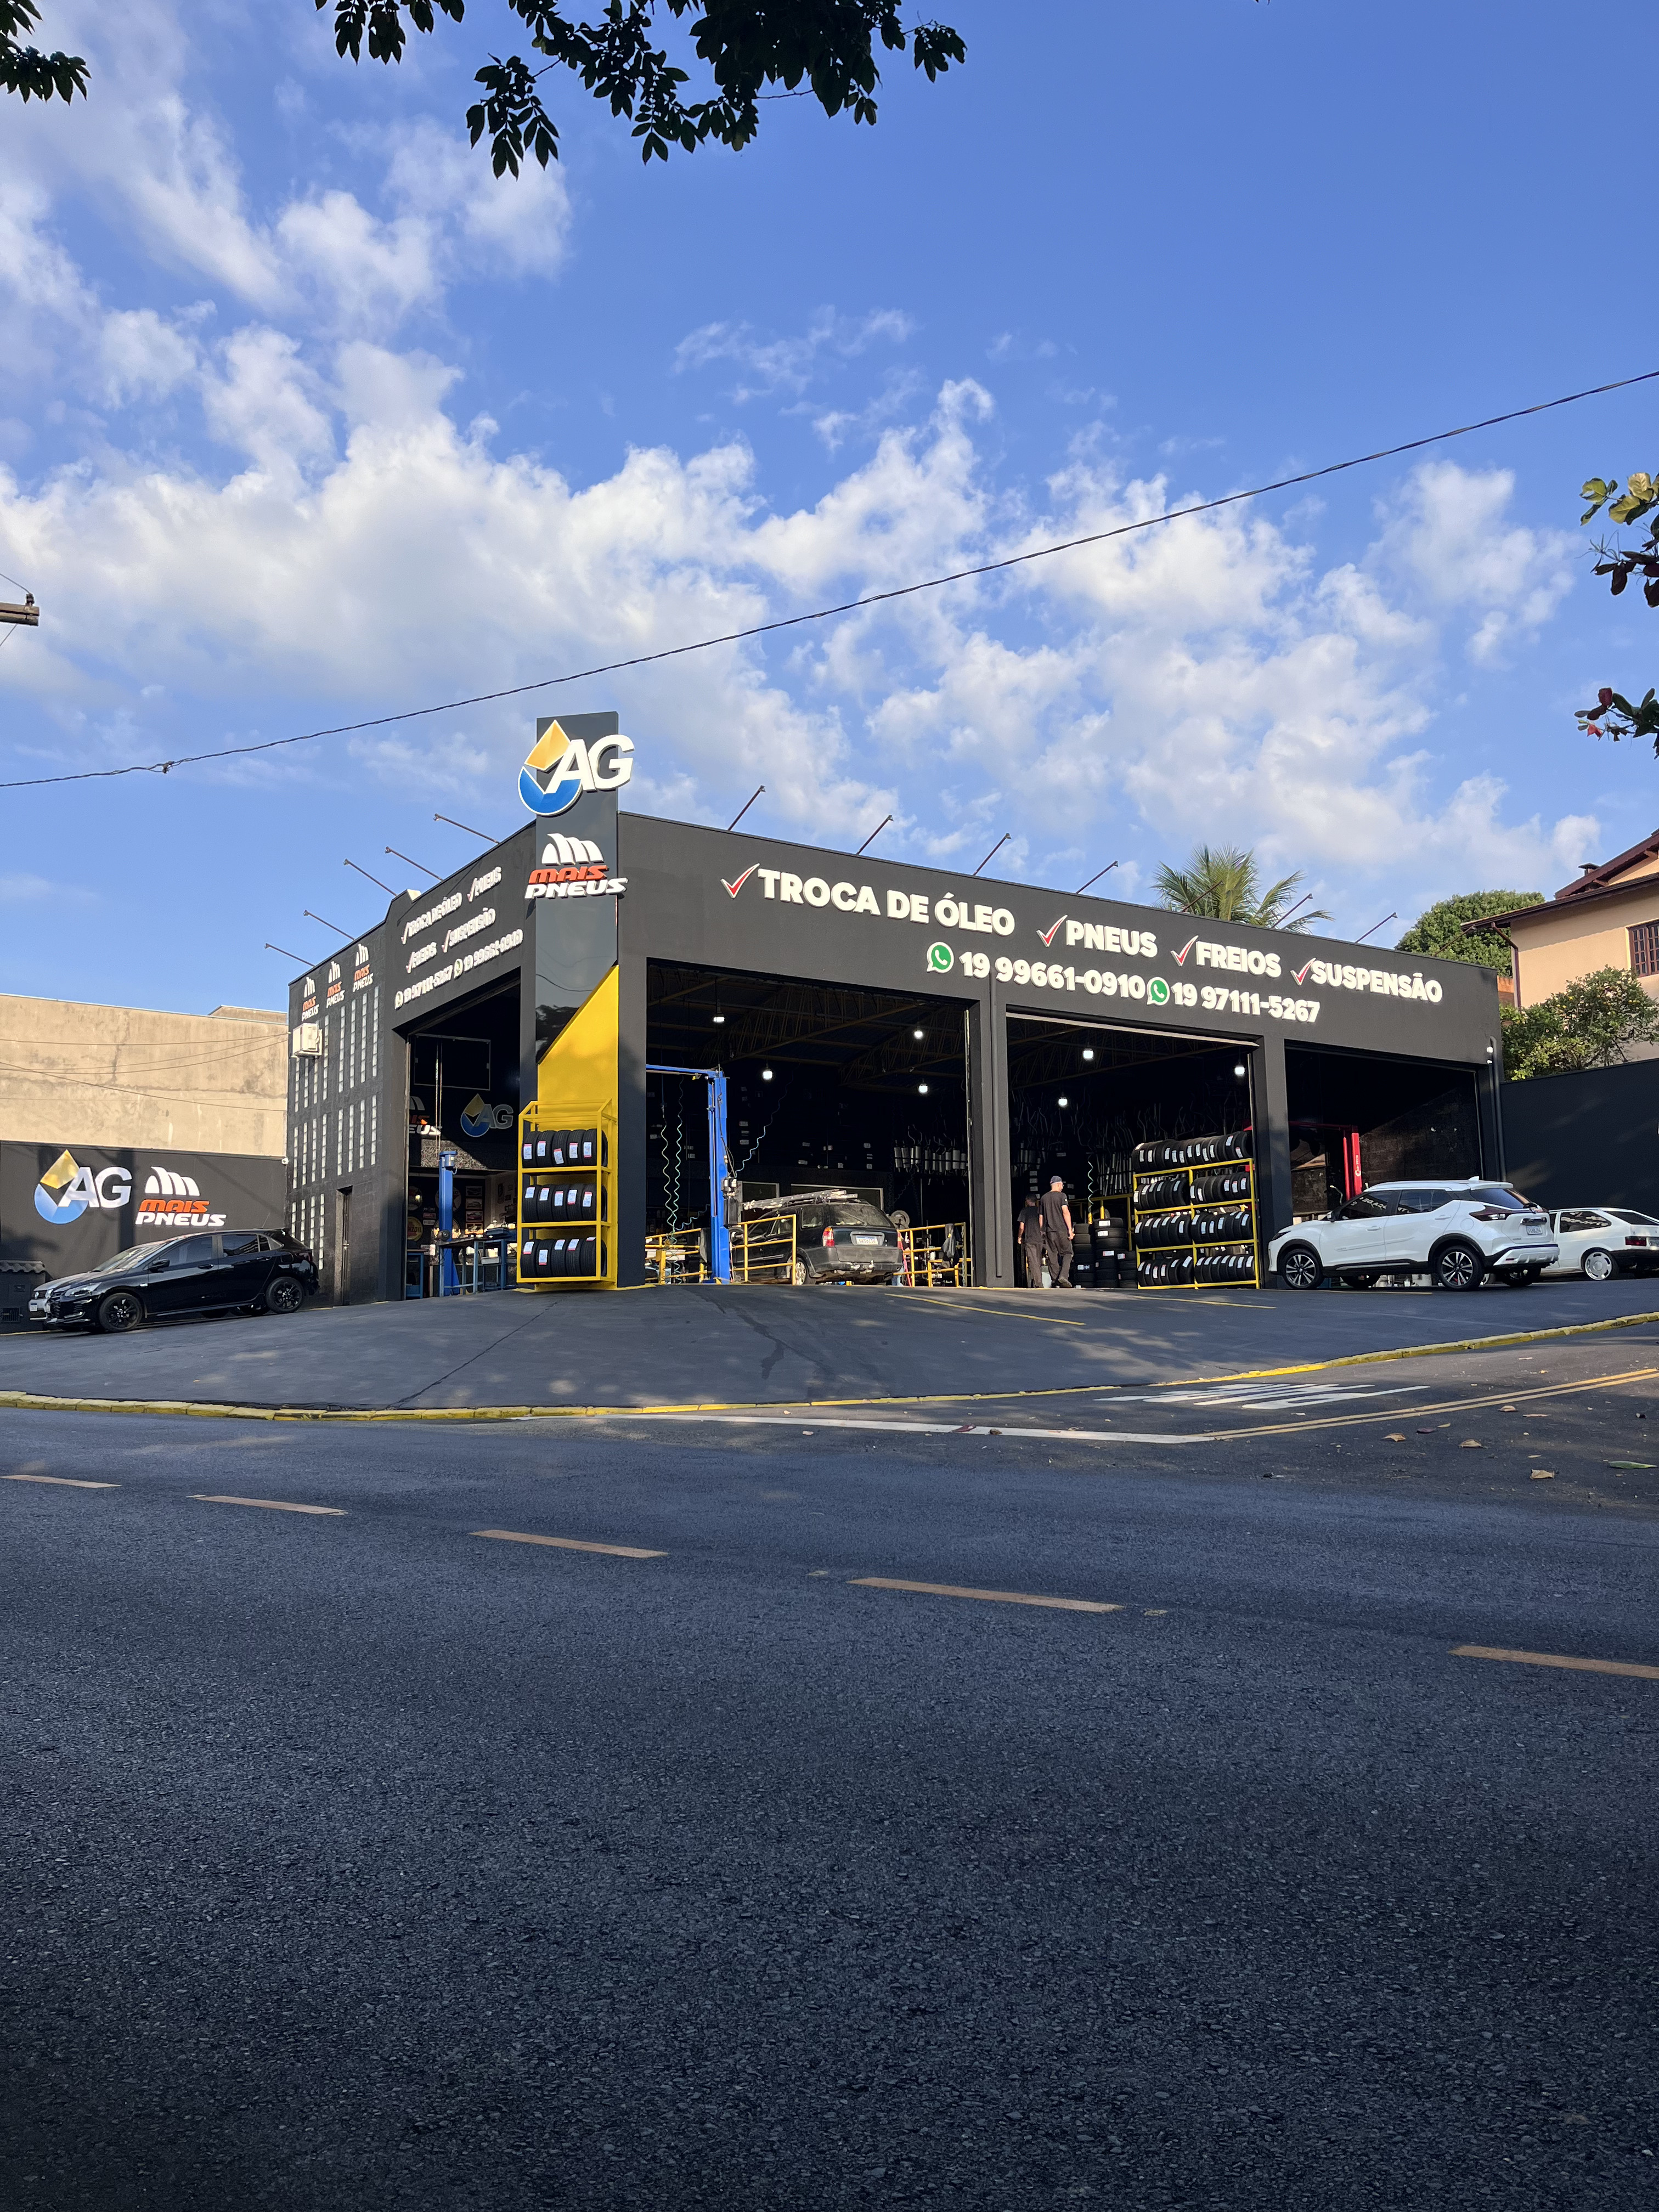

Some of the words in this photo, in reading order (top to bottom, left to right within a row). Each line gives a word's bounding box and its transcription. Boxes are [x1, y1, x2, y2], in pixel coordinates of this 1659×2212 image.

[544, 734, 635, 794] AG
[475, 866, 502, 896] PNEUS
[528, 865, 609, 884] MAIS
[524, 877, 628, 899] PNEUS
[758, 868, 881, 916] TROCA
[887, 889, 929, 924] DE
[934, 892, 1015, 936] ÓLEO
[1065, 919, 1158, 959] PNEUS
[411, 941, 437, 968] FREIOS
[1195, 941, 1282, 979] FREIOS
[353, 973, 374, 992] PNEUS
[354, 964, 370, 981] MAIS
[959, 951, 990, 980] 19
[994, 956, 1145, 1000] 99661-0910
[1310, 960, 1443, 1003] SUSPENSÃO
[326, 990, 345, 1008] PNEUS
[328, 981, 342, 997] MAIS
[301, 1004, 319, 1022] PNEUS
[302, 996, 317, 1012] MAIS
[1172, 981, 1198, 1008] 19
[1201, 985, 1321, 1024] 97111-5267
[474, 1104, 514, 1129] AG
[409, 1125, 443, 1135] EUS
[57, 1166, 133, 1209] AG
[139, 1199, 210, 1214] MAIS
[136, 1212, 227, 1227] PNEUS
